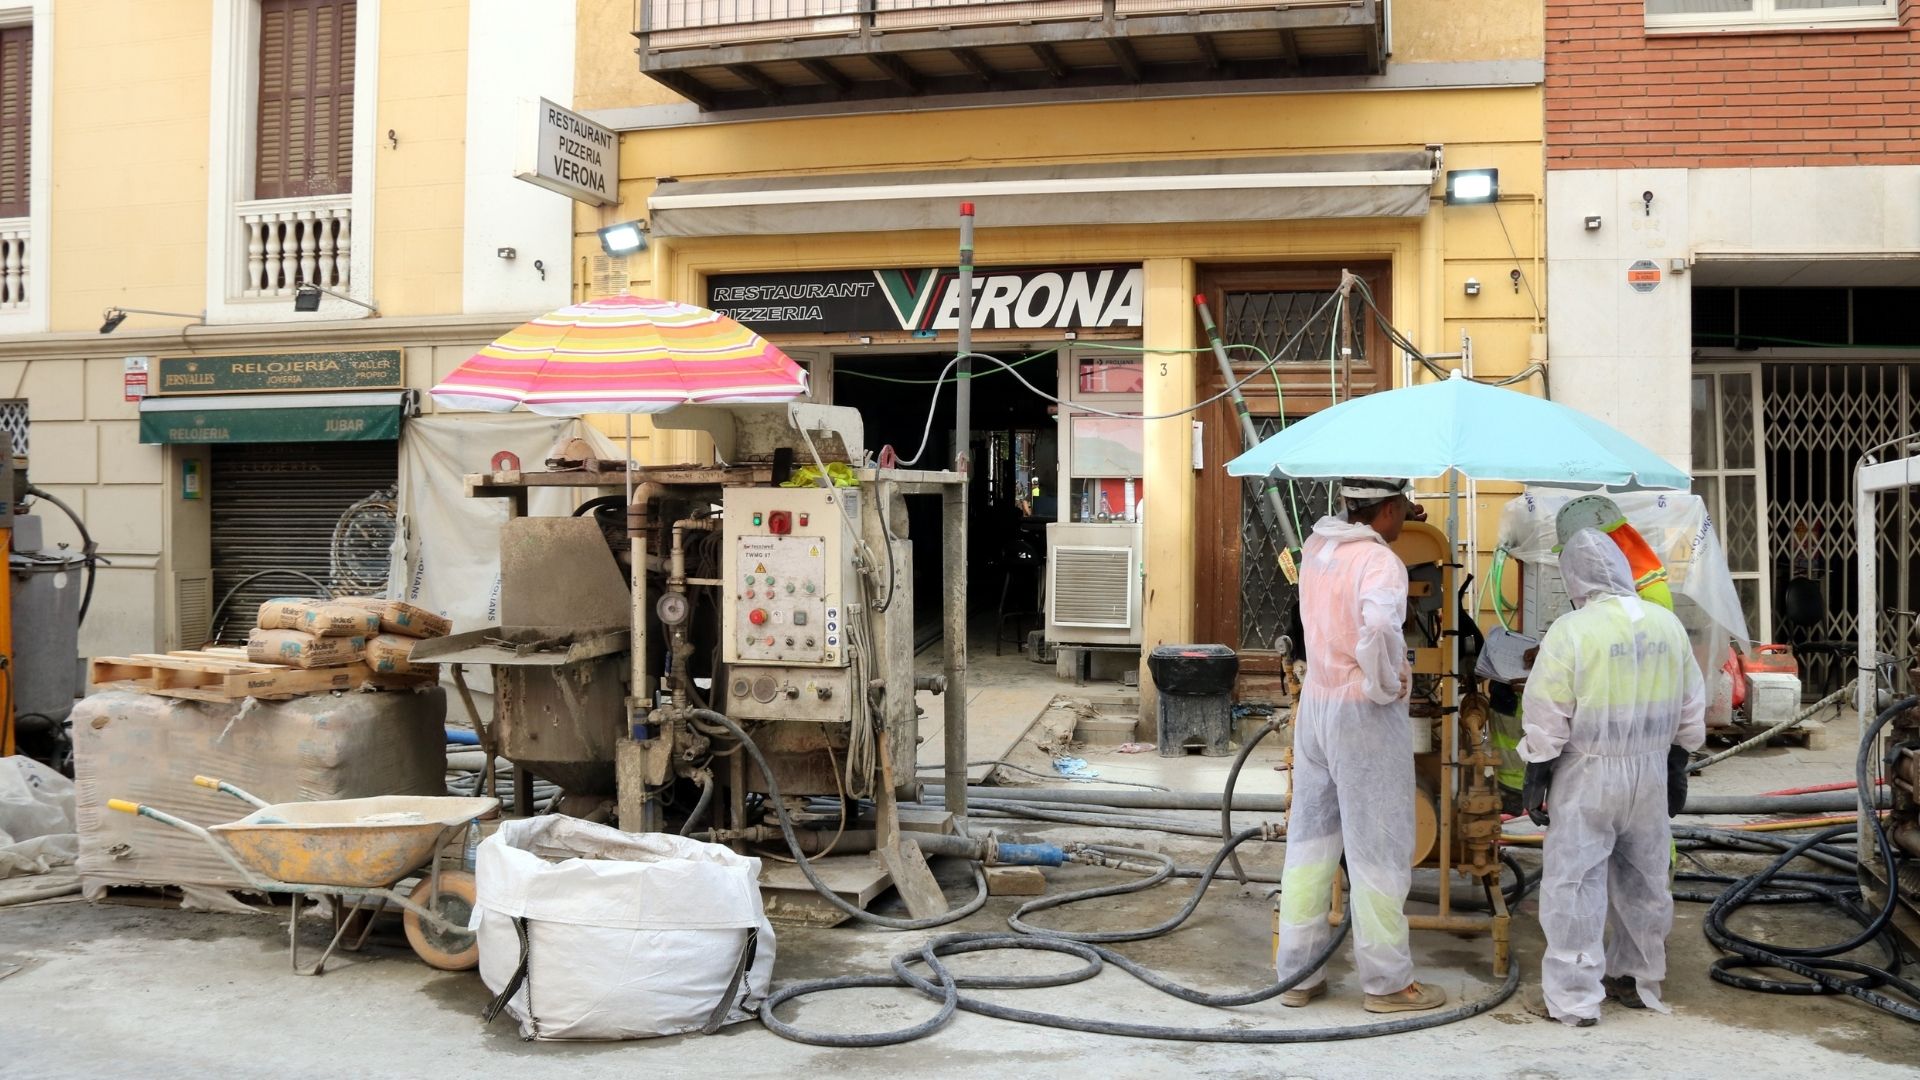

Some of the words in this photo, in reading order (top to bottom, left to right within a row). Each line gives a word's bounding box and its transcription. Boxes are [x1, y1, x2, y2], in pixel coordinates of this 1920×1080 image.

[548, 108, 612, 150] RESTAURANT
[559, 135, 602, 167] PIZZERIA
[554, 155, 606, 193] VERONA
[713, 282, 876, 302] RESTAURANT
[872, 267, 1143, 331] VERONA
[714, 305, 824, 322] PIZZERIA
[231, 360, 340, 374] RELOJERIA
[352, 360, 391, 370] TALLER
[1160, 363, 1168, 376] 3
[266, 375, 303, 385] JOYERIA
[355, 371, 387, 379] PROPIO
[324, 419, 365, 432] JUBAR
[169, 428, 231, 440] RELOJERIA
